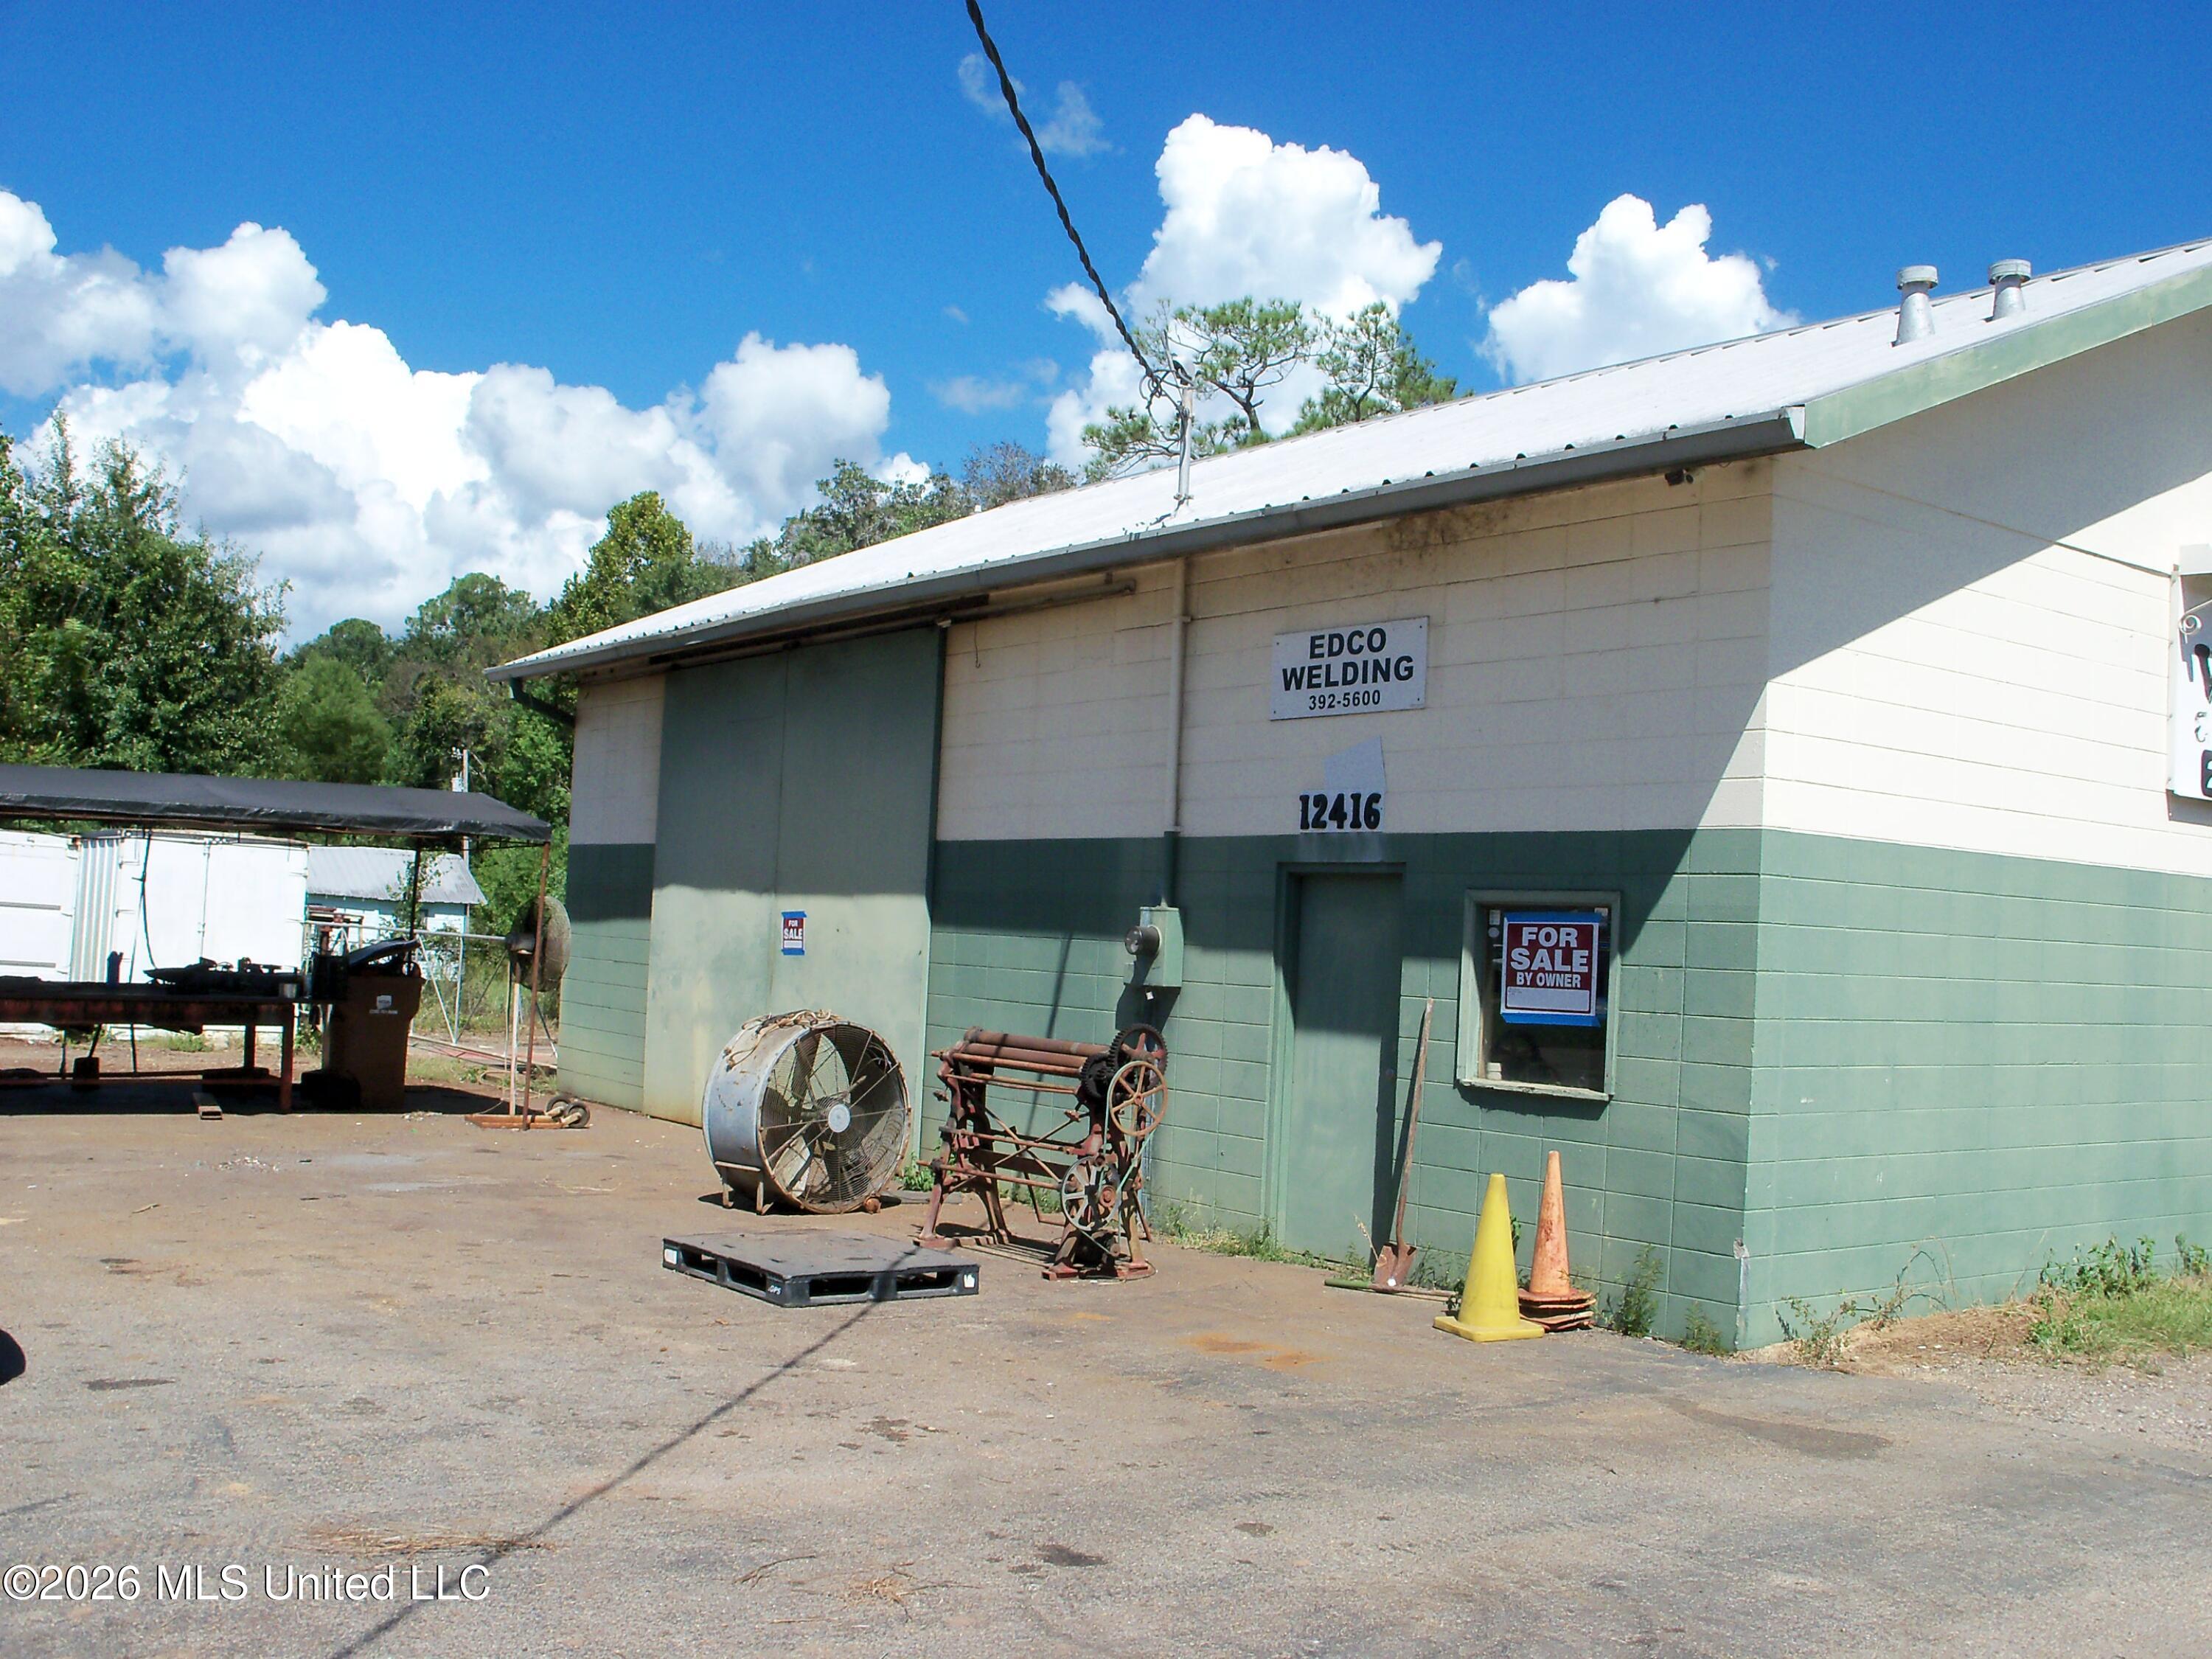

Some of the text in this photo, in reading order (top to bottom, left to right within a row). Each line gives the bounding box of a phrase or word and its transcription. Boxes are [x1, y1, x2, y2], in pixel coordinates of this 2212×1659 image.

[1310, 627, 1386, 659] EDCO
[1282, 655, 1414, 692] WELDING
[1309, 689, 1381, 710] 392-5600
[1299, 793, 1382, 830] 12416
[784, 928, 803, 939] SALE
[1521, 927, 1578, 947] FOR
[1510, 947, 1589, 973] SALE
[1516, 972, 1581, 988] BY OWNER
